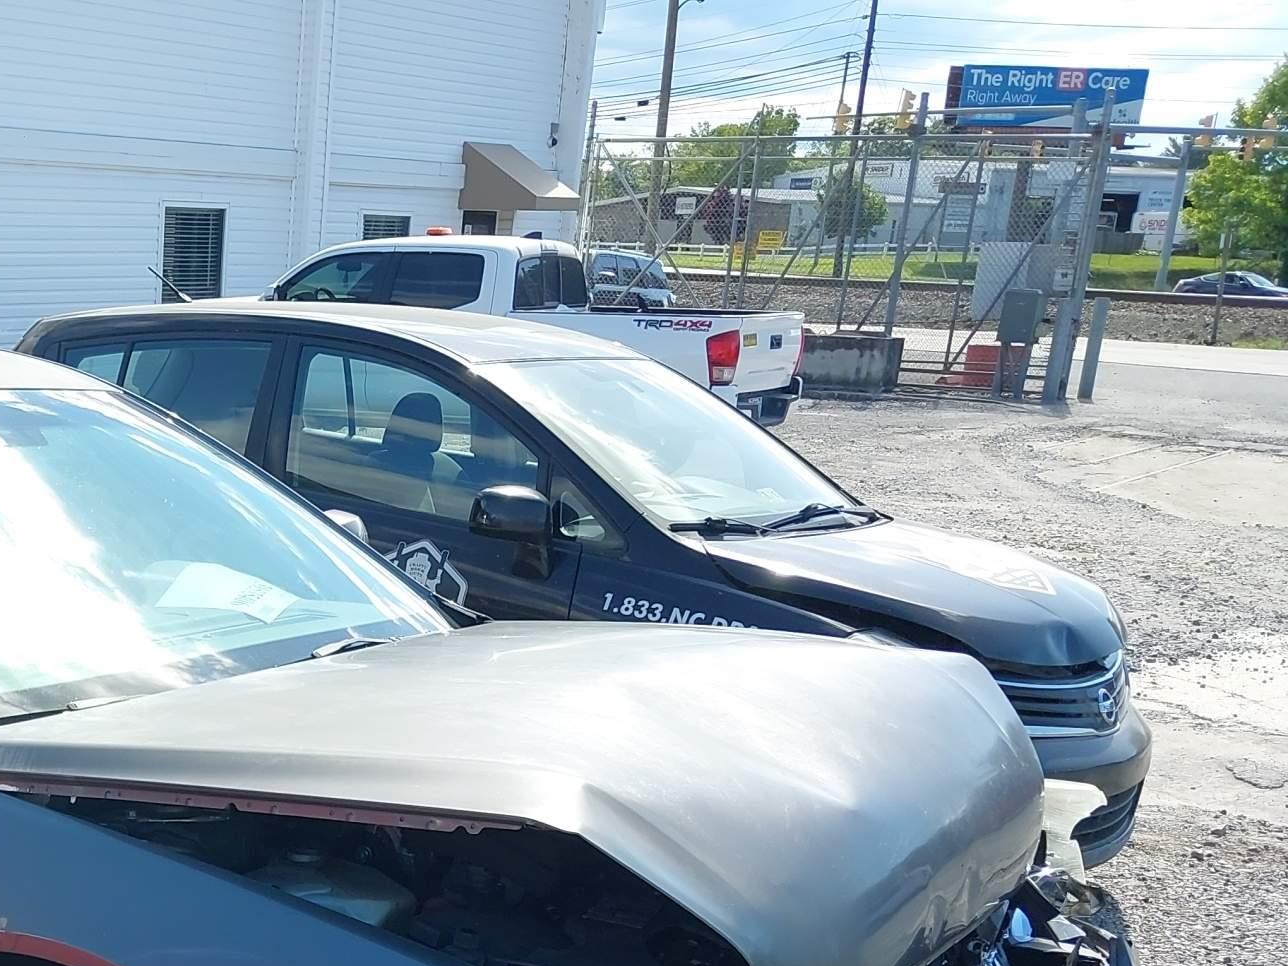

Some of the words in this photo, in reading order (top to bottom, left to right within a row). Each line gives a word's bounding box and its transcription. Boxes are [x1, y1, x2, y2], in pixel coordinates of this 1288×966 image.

[970, 69, 1002, 86] The
[1008, 70, 1053, 89] Right
[1058, 71, 1084, 89] ER
[1088, 73, 1130, 89] Care
[967, 90, 999, 105] Right
[1001, 91, 1037, 105] Away
[633, 319, 674, 330] TRD
